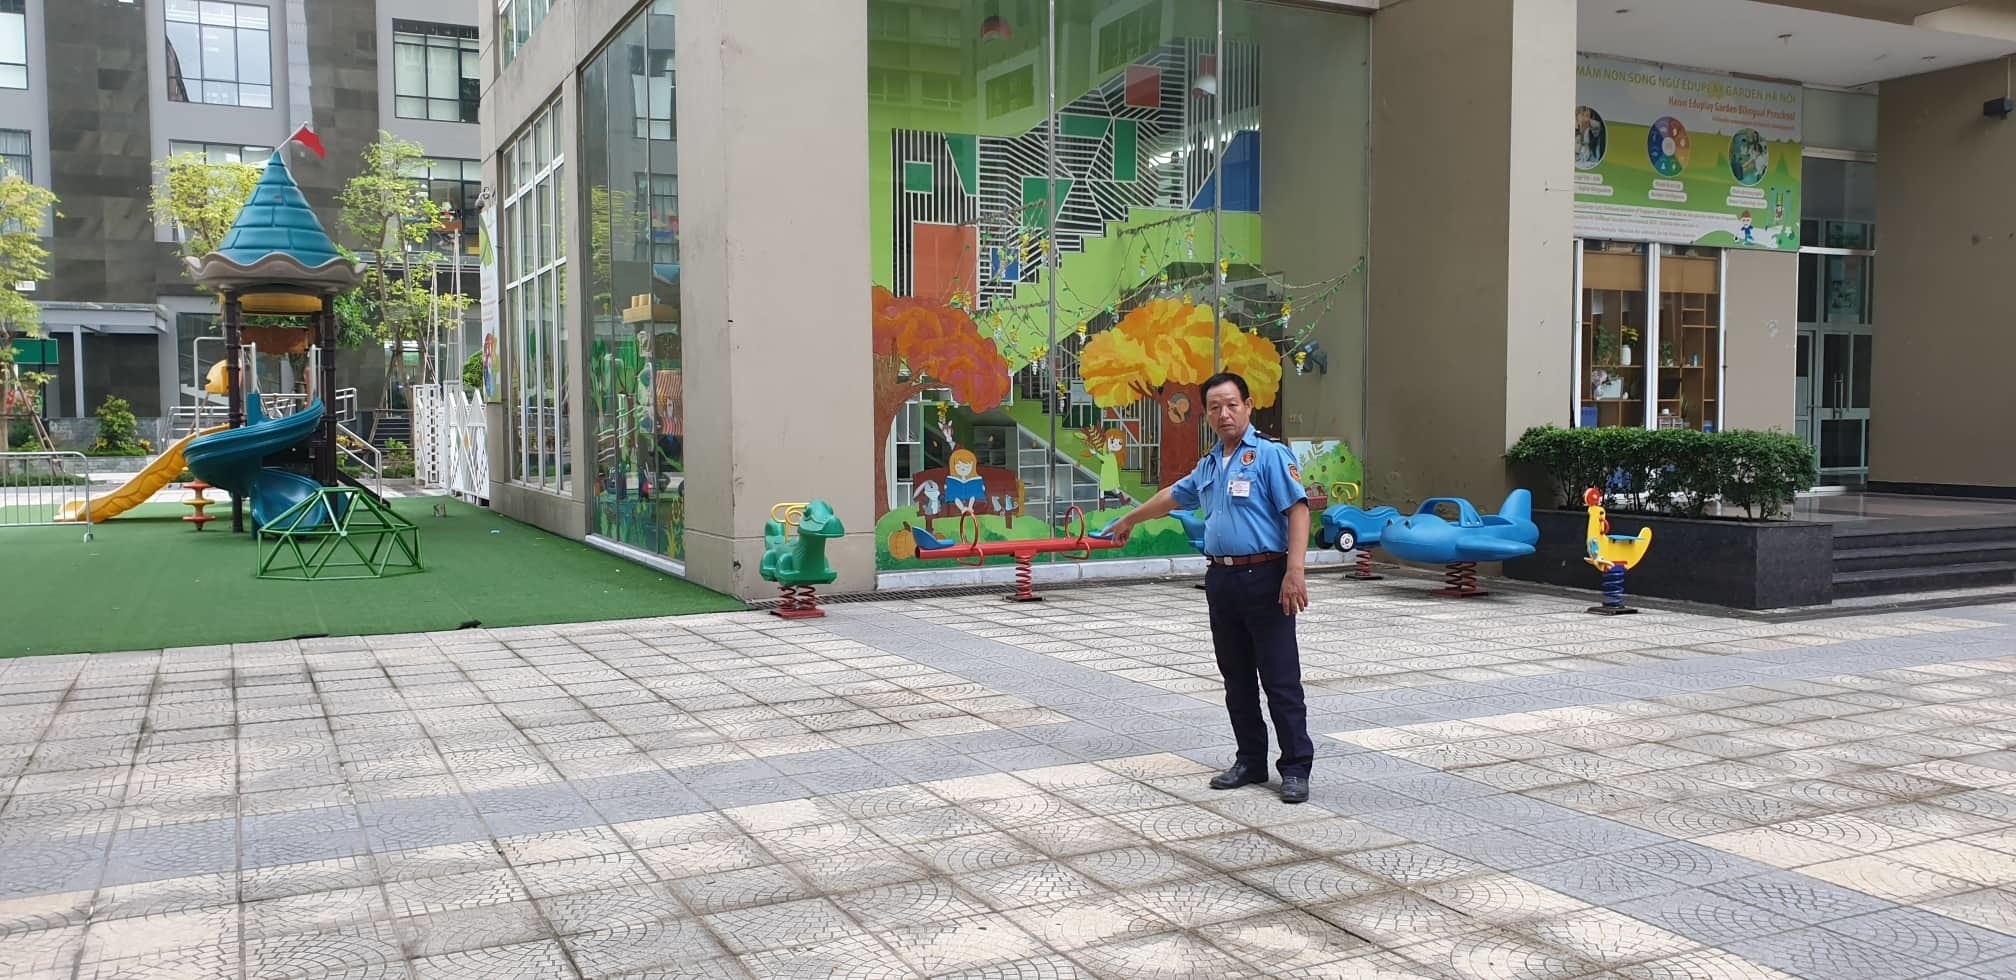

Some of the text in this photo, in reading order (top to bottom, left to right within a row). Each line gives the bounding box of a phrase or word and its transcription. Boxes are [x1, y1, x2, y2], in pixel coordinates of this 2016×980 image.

[1604, 68, 1626, 81] NON
[1628, 70, 1656, 86] SONG
[1726, 86, 1763, 100] GARDEN
[1688, 98, 1714, 113] Eduplay
[1714, 102, 1737, 114] Garden
[1738, 104, 1766, 118] Bilingual
[1766, 107, 1796, 121] Preschool
